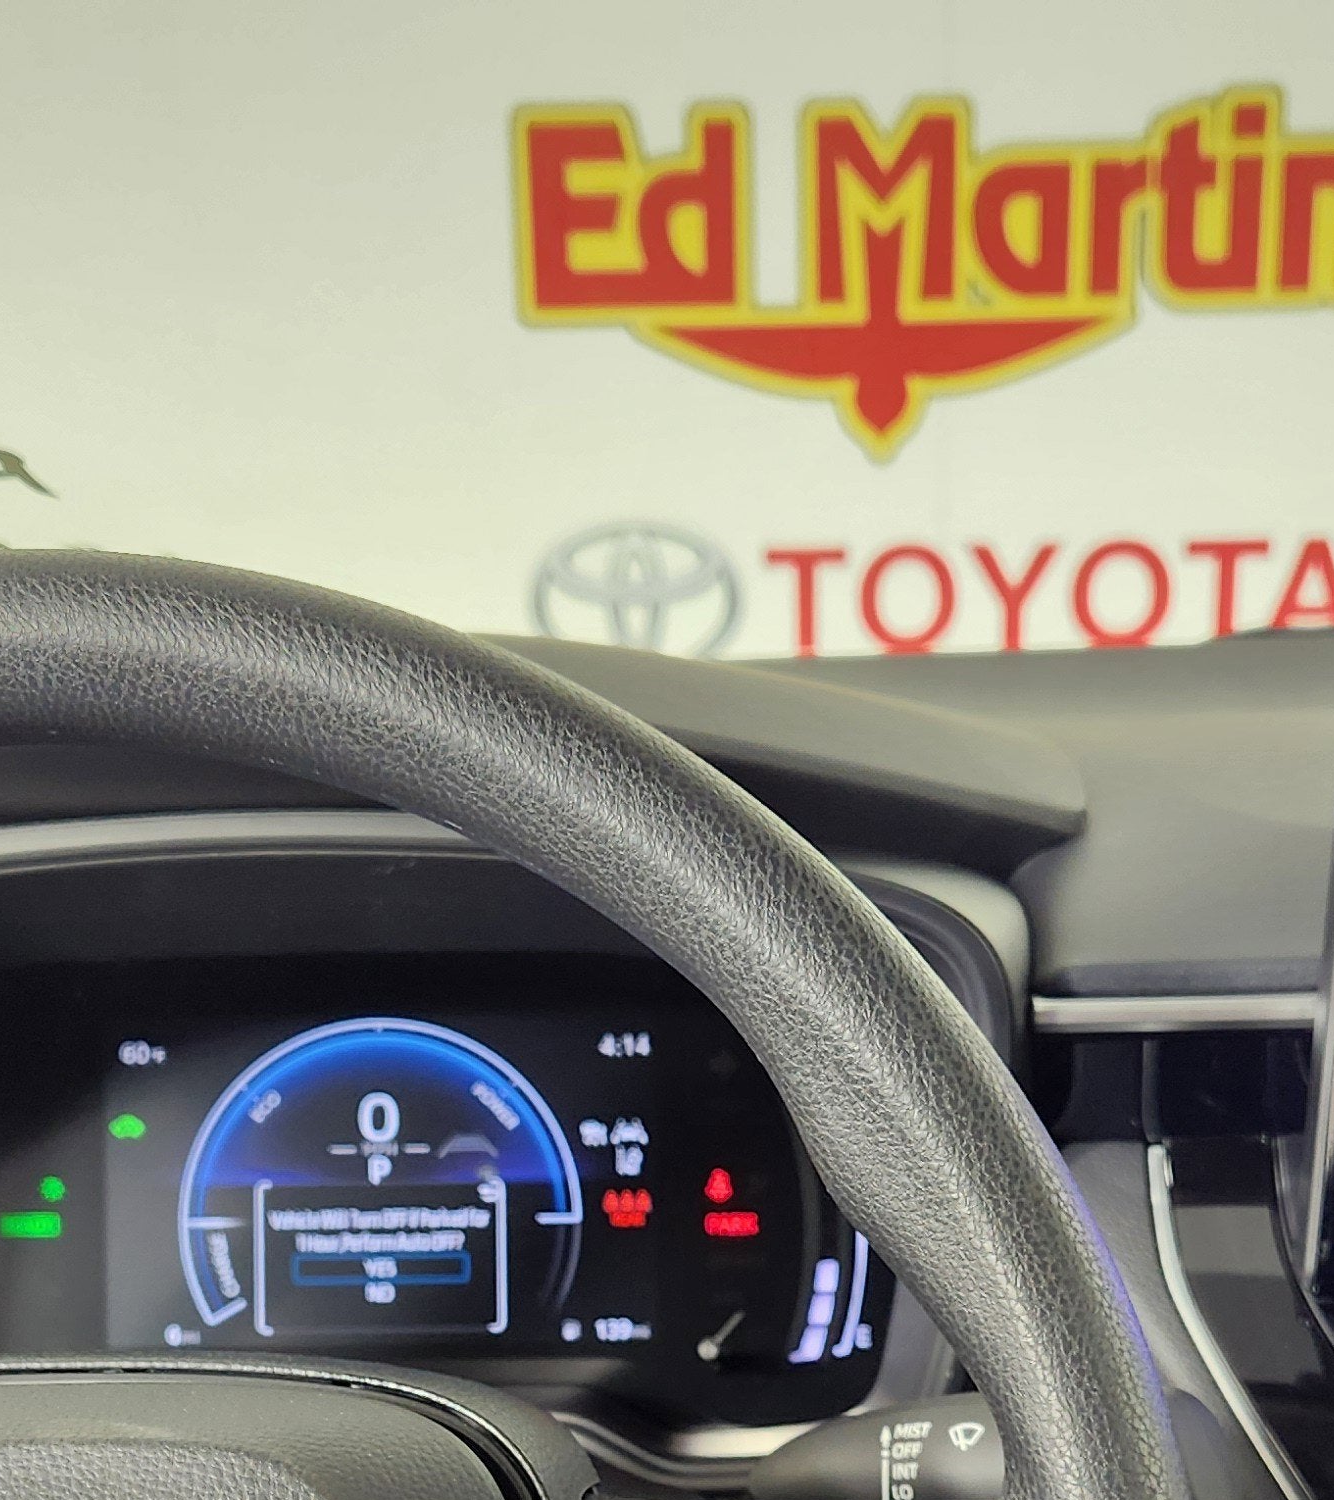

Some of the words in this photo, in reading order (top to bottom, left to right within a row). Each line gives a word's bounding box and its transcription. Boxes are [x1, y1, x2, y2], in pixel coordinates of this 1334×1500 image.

[513, 102, 749, 326] Ed
[367, 1153, 393, 1186] P
[893, 1421, 933, 1440] MIST
[891, 1441, 923, 1460] OFF
[891, 1461, 919, 1480] INT
[891, 1483, 915, 1500] LO
